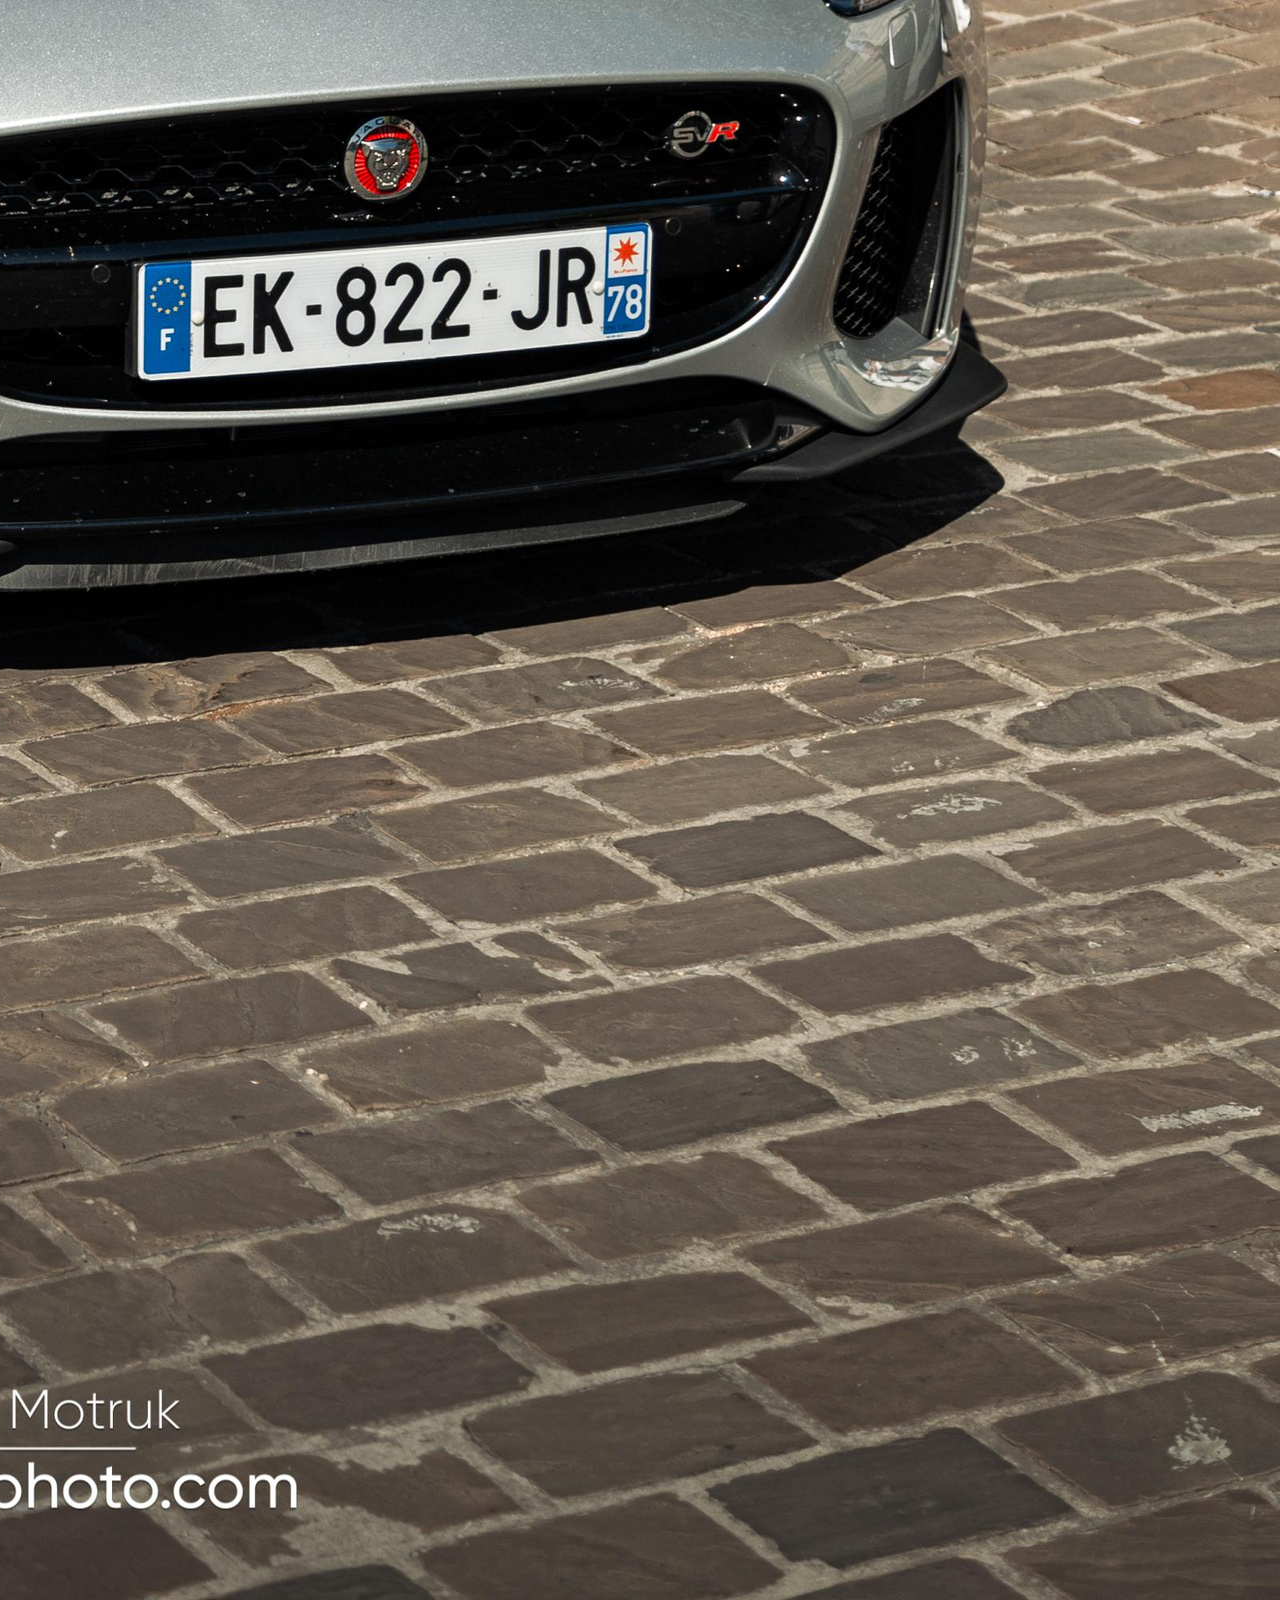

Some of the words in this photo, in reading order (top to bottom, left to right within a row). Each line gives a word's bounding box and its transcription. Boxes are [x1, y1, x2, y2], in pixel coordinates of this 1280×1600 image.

[352, 117, 421, 144] JAGUAR
[672, 120, 740, 143] SVR
[203, 247, 596, 358] EK-822-JR
[607, 284, 643, 322] 78
[160, 328, 174, 351] F
